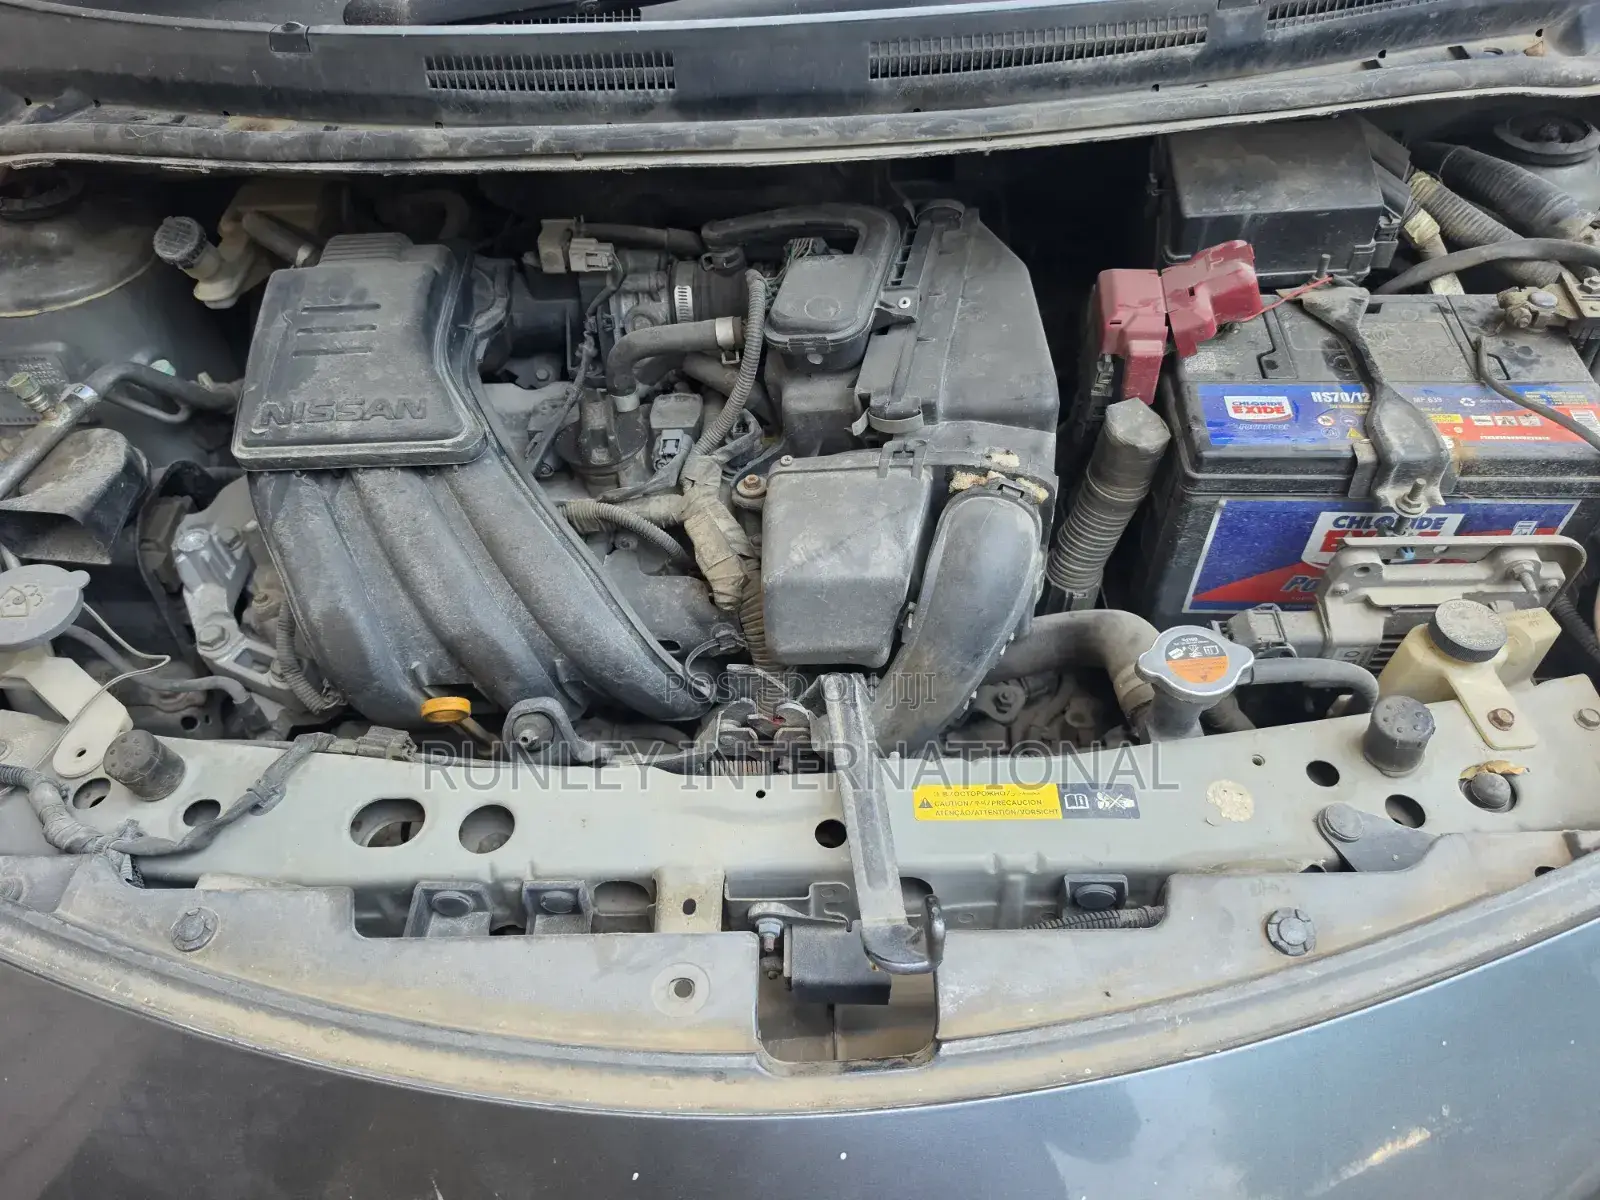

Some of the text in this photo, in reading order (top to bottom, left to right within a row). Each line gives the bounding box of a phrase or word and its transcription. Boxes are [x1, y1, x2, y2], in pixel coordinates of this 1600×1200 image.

[259, 398, 428, 426] NISSAN
[1232, 406, 1286, 414] EXIDE
[1332, 514, 1449, 530] CHLOIDE
